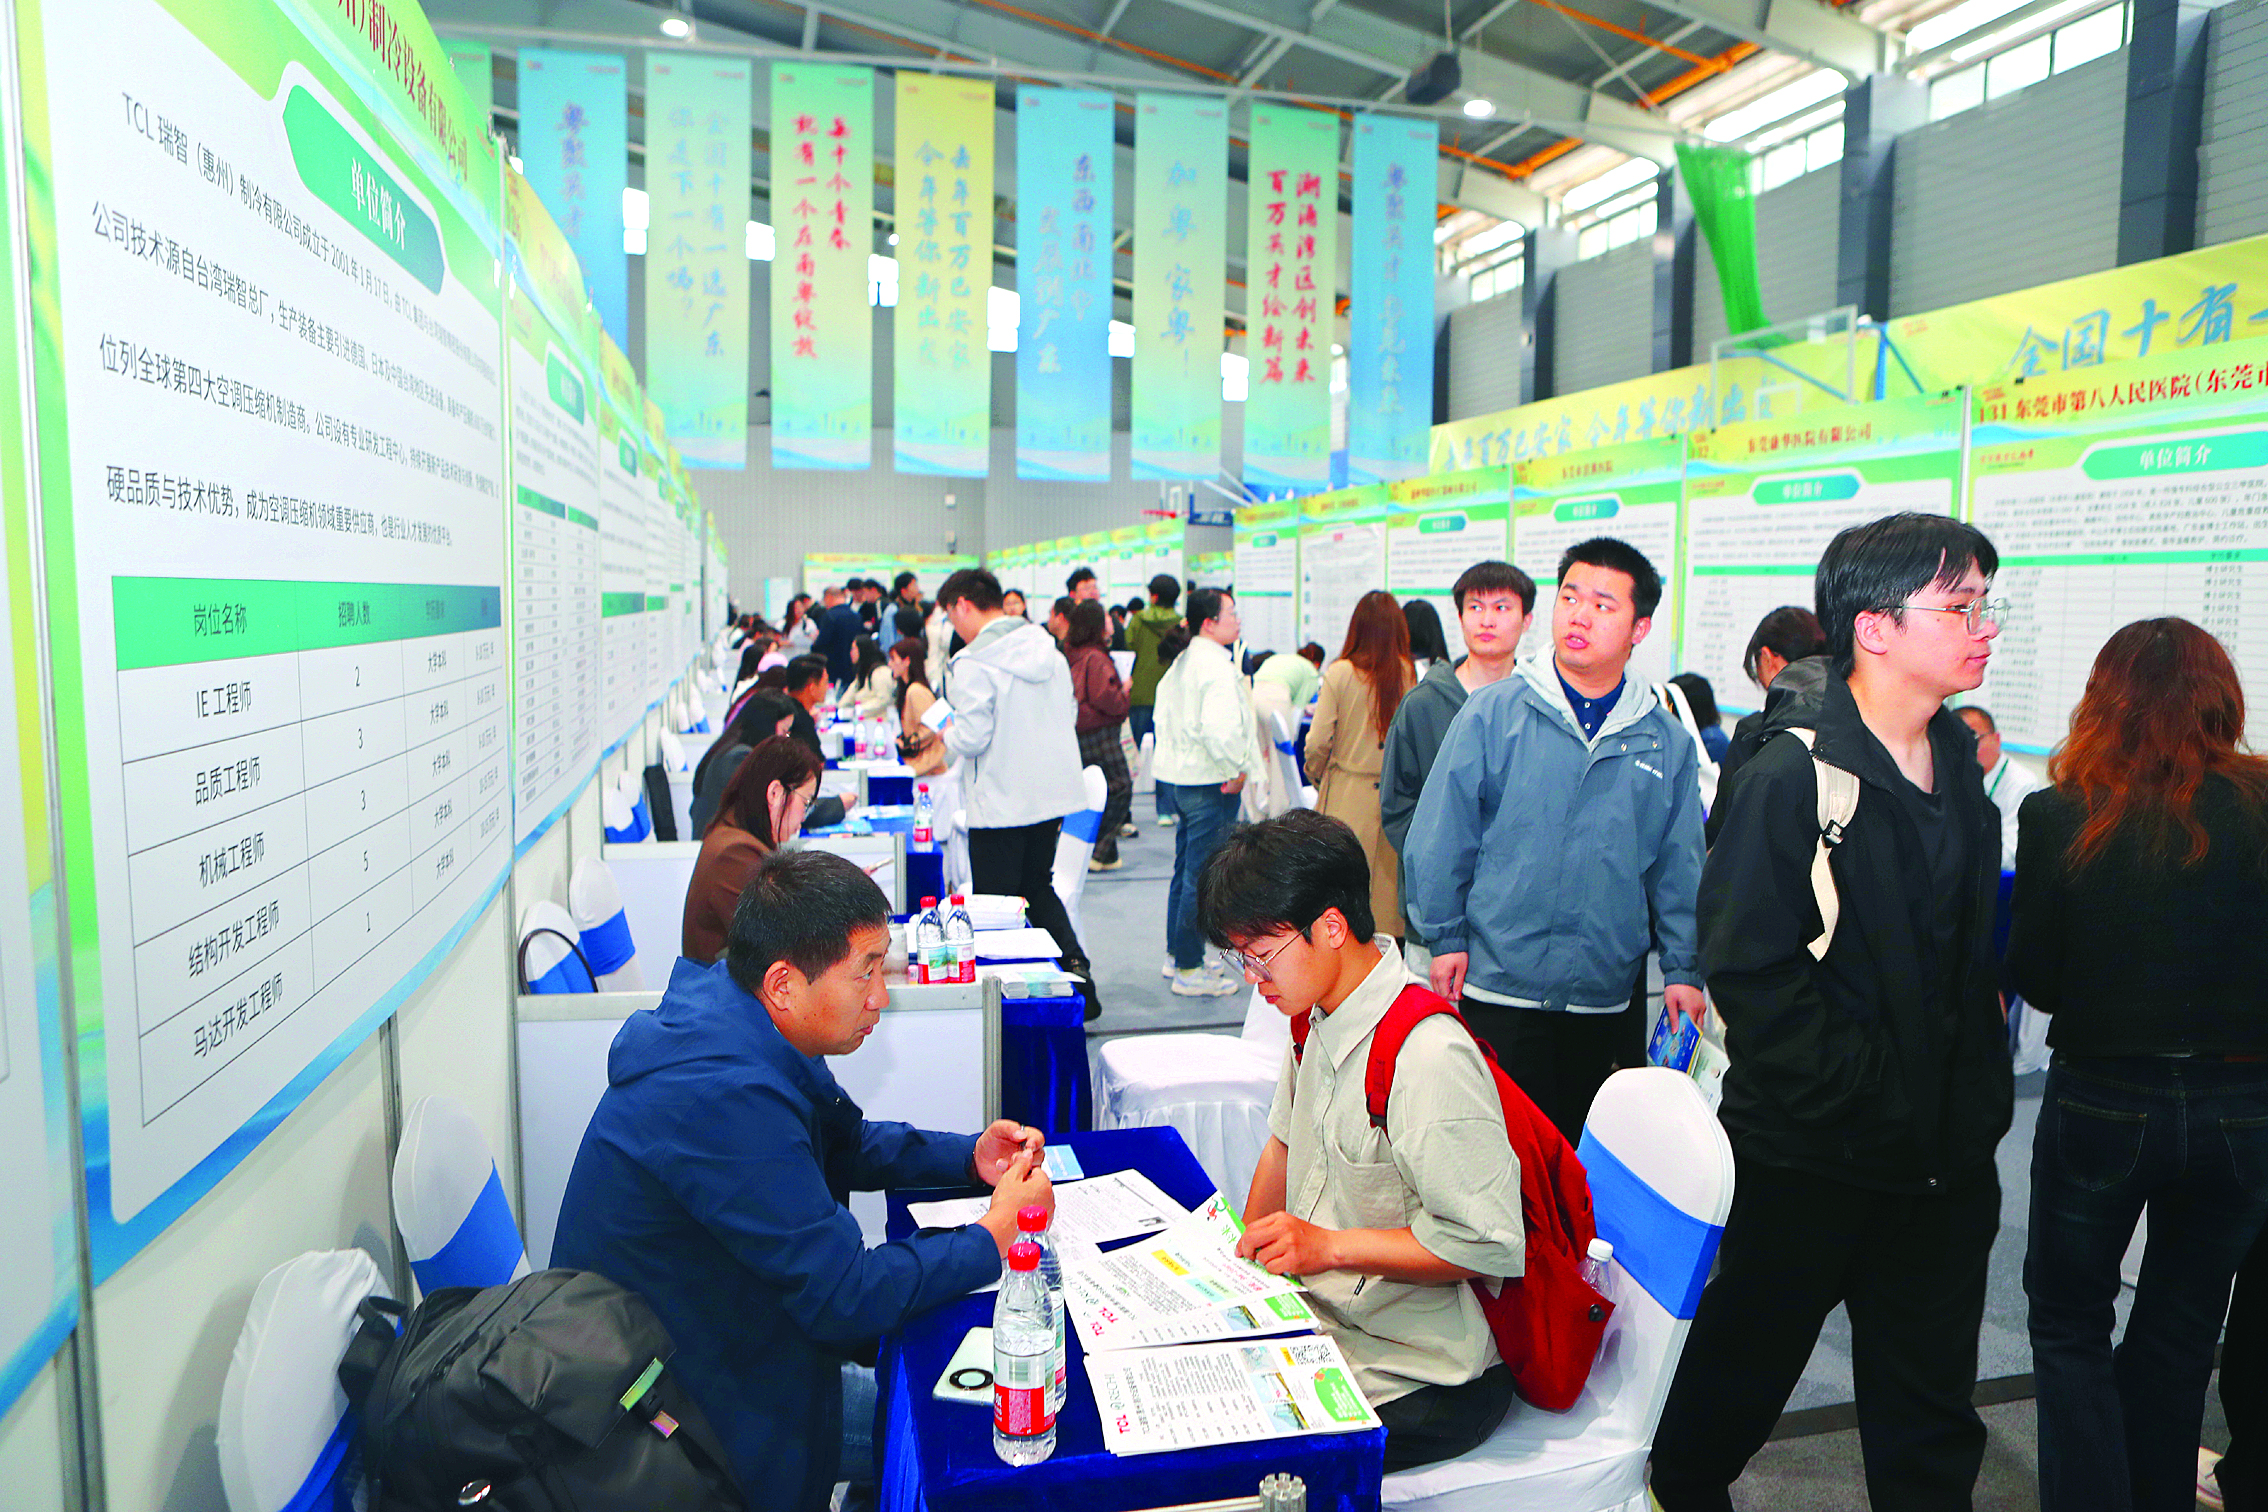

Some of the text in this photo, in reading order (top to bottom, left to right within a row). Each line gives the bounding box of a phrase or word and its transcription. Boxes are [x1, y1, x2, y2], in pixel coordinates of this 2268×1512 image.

[351, 156, 406, 250] 单位简介
[1070, 152, 1097, 322] 东西南北中
[914, 139, 944, 364] 今年等你新出发
[945, 143, 973, 369] 去年百万已安家
[1260, 169, 1288, 383] 百万英才绘新篇
[1979, 404, 2006, 423] 131
[2140, 443, 2212, 470] 单位简介
[193, 602, 248, 637] 岗位名称
[338, 600, 371, 628] 招聘人数
[427, 650, 448, 674] 大学本科
[197, 681, 253, 719] IE 工程师
[355, 666, 361, 688] 2
[195, 702, 449, 807] 品质工程师 3 大学本科
[199, 753, 452, 889] 机械工程师 3 大学本科
[188, 900, 279, 979] 结构开发工程师
[363, 850, 369, 873] 5
[434, 803, 453, 829] 大学本科
[194, 850, 455, 1059] 马达开发工程师 1 大学本科
[1098, 1306, 1118, 1323] TCL
[1116, 1414, 1131, 1434] TCL
